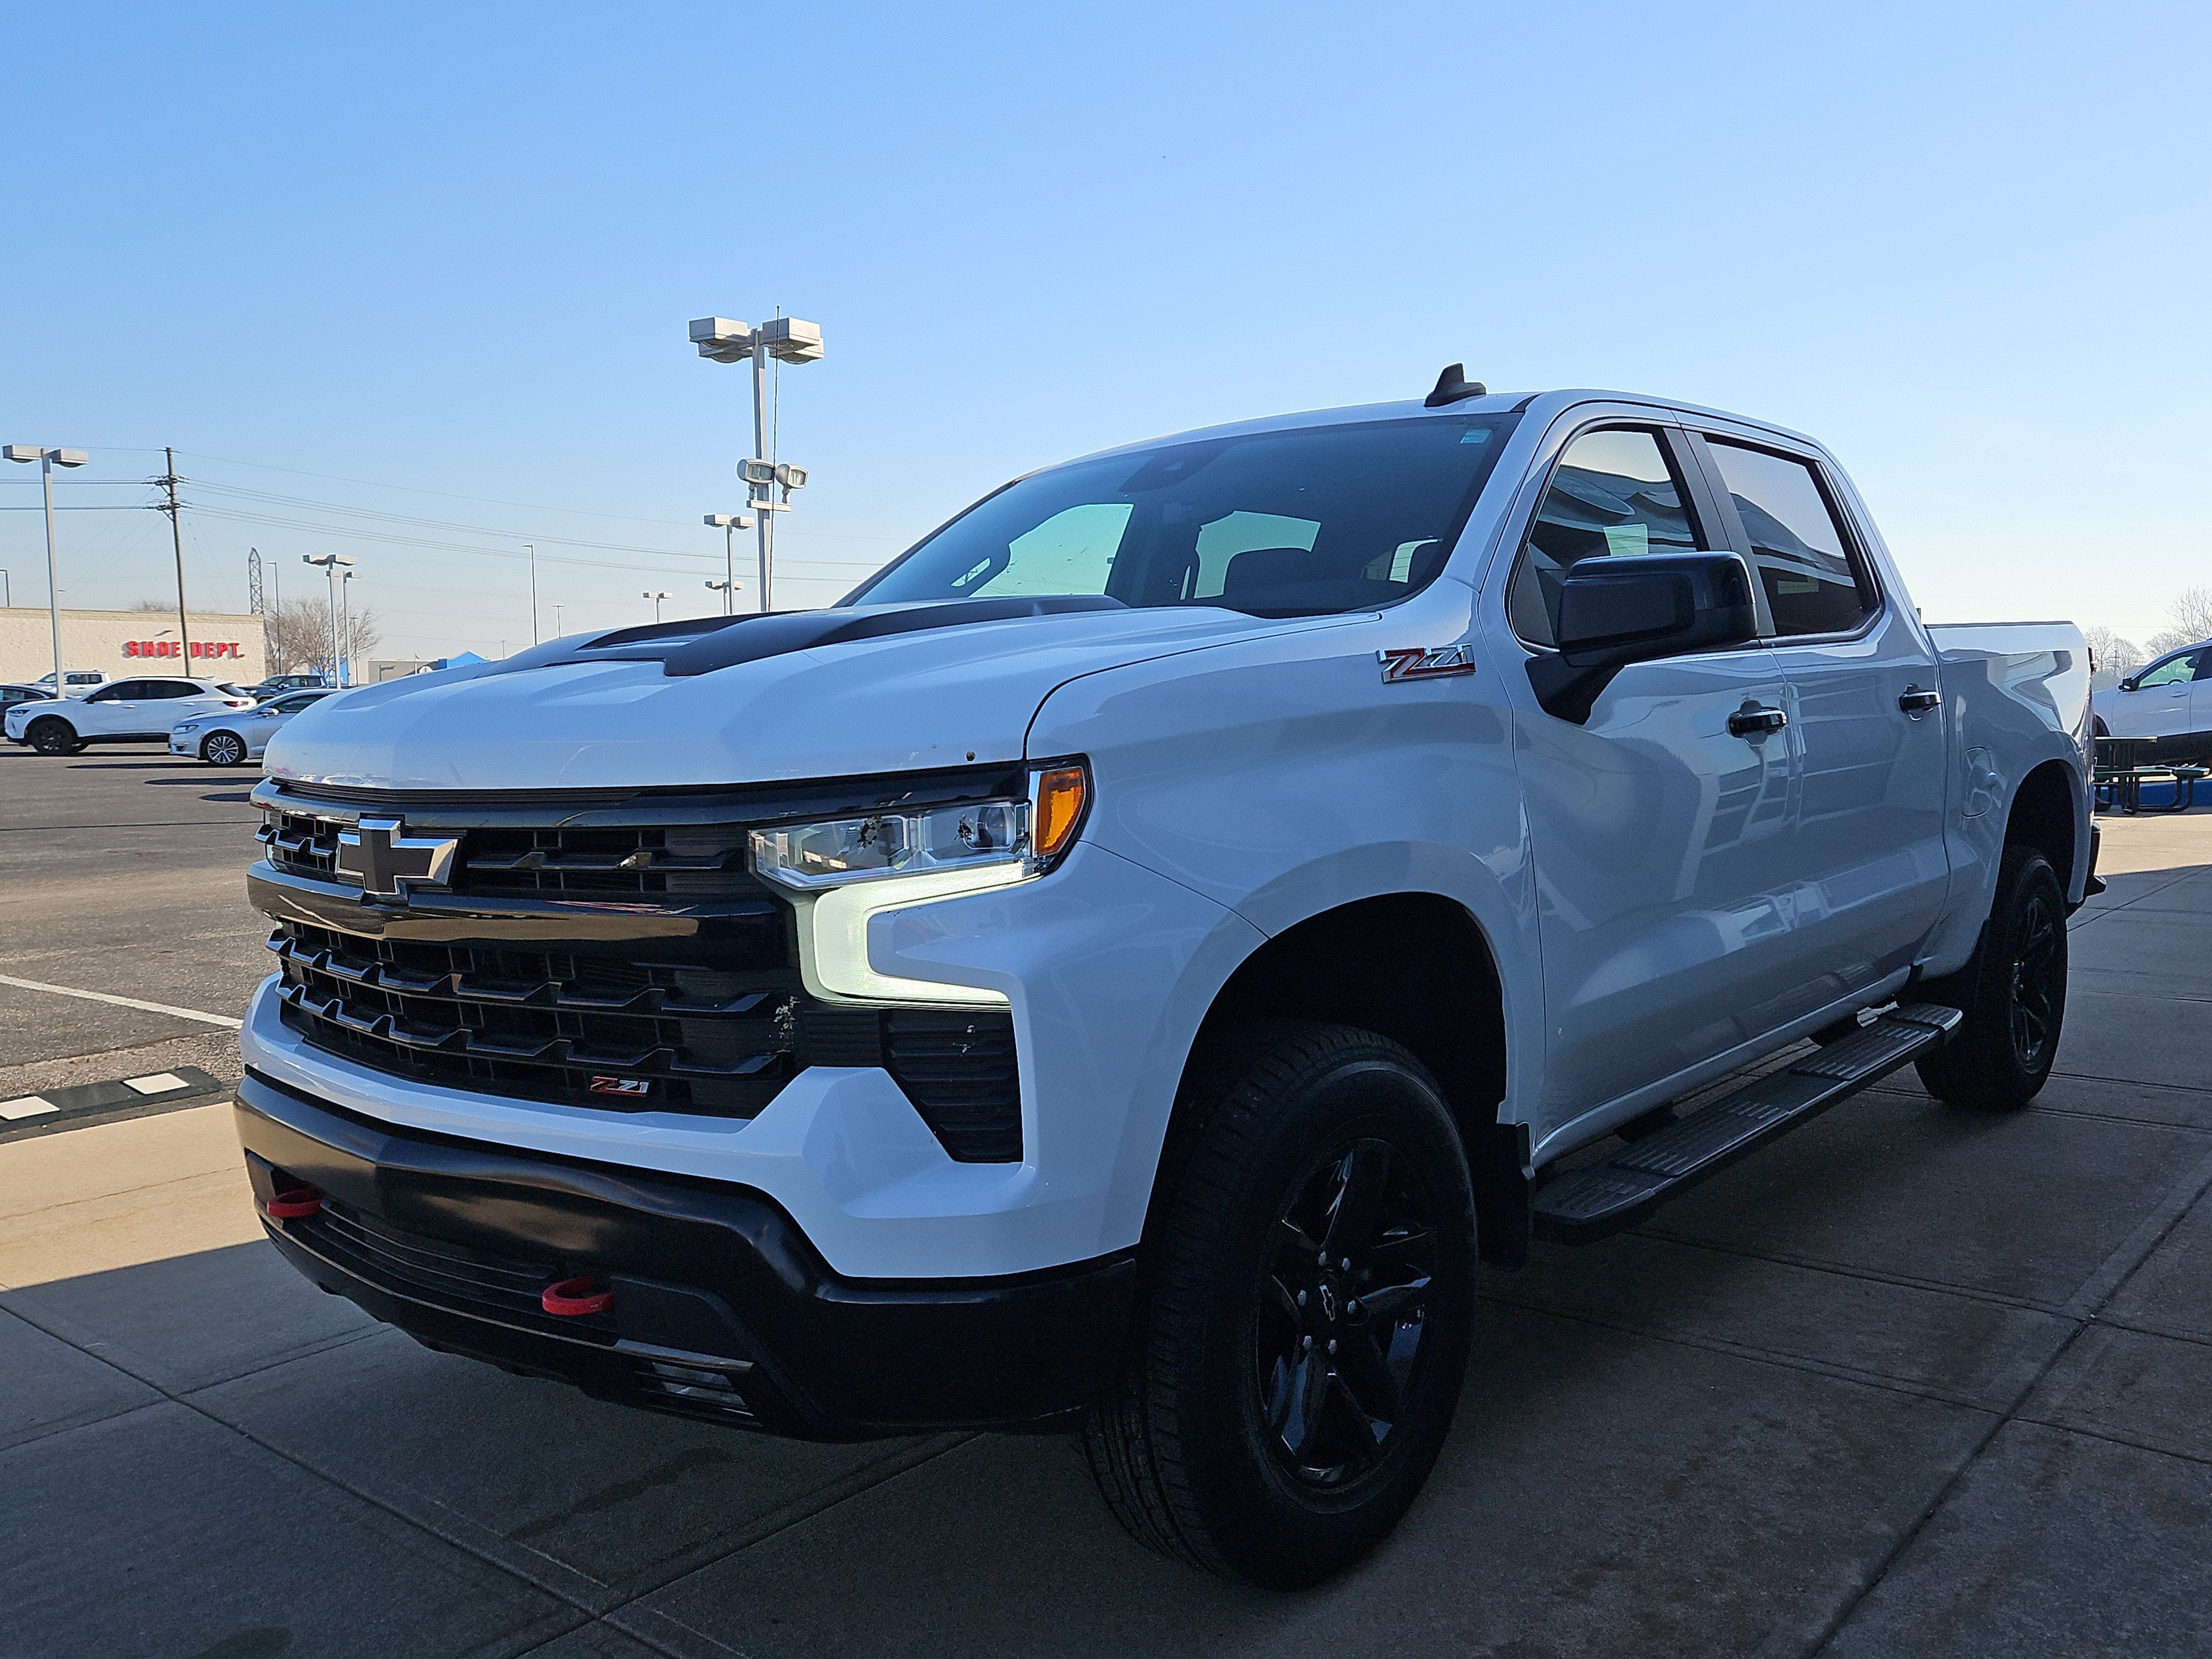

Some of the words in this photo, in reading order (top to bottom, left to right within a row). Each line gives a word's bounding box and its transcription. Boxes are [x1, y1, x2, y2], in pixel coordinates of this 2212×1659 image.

[126, 640, 181, 657] SHOE
[190, 641, 245, 658] DEPT.
[1375, 643, 1476, 684] Z71
[589, 1076, 650, 1097] Z71
